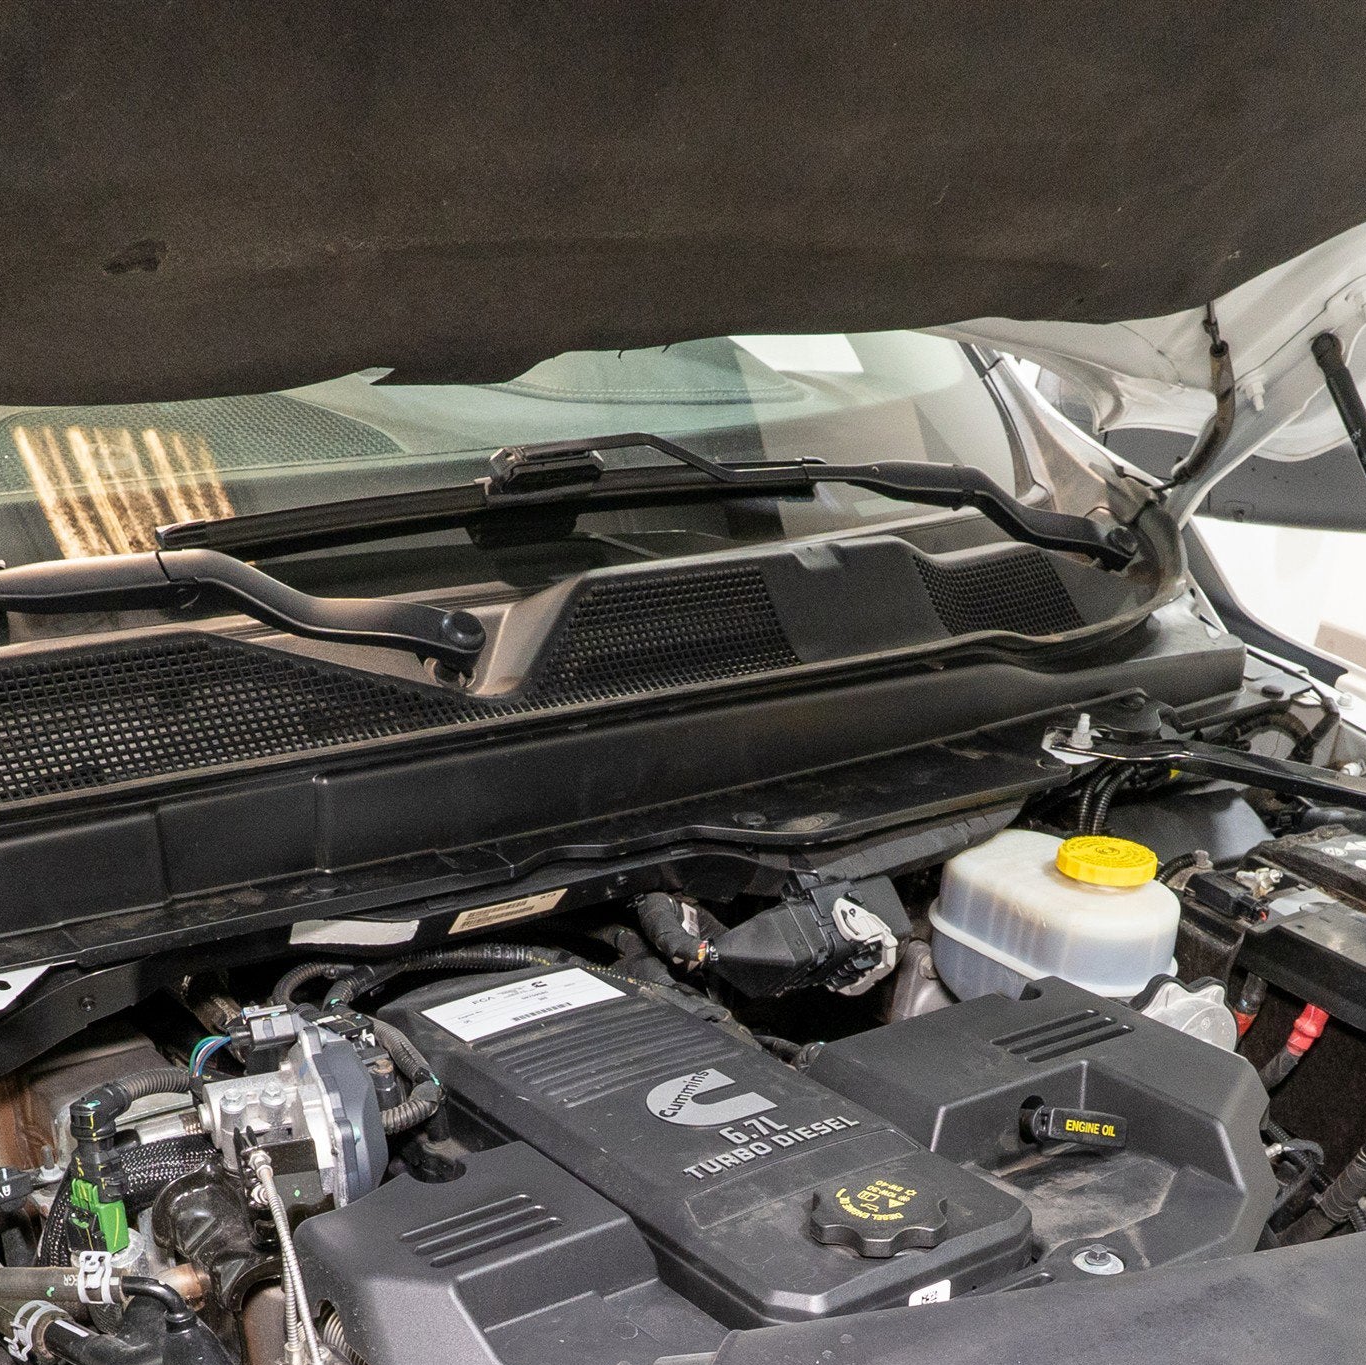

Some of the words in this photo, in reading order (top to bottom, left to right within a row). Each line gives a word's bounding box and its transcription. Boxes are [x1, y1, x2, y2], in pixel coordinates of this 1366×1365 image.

[659, 1071, 709, 1118] Cummins
[719, 1116, 788, 1145] 6.7L
[1065, 1119, 1100, 1135] ENGINE
[1101, 1125, 1115, 1137] OIL
[683, 1141, 773, 1180] TURBO
[771, 1115, 860, 1148] DIESEL
[866, 1185, 897, 1198] 10W-30
